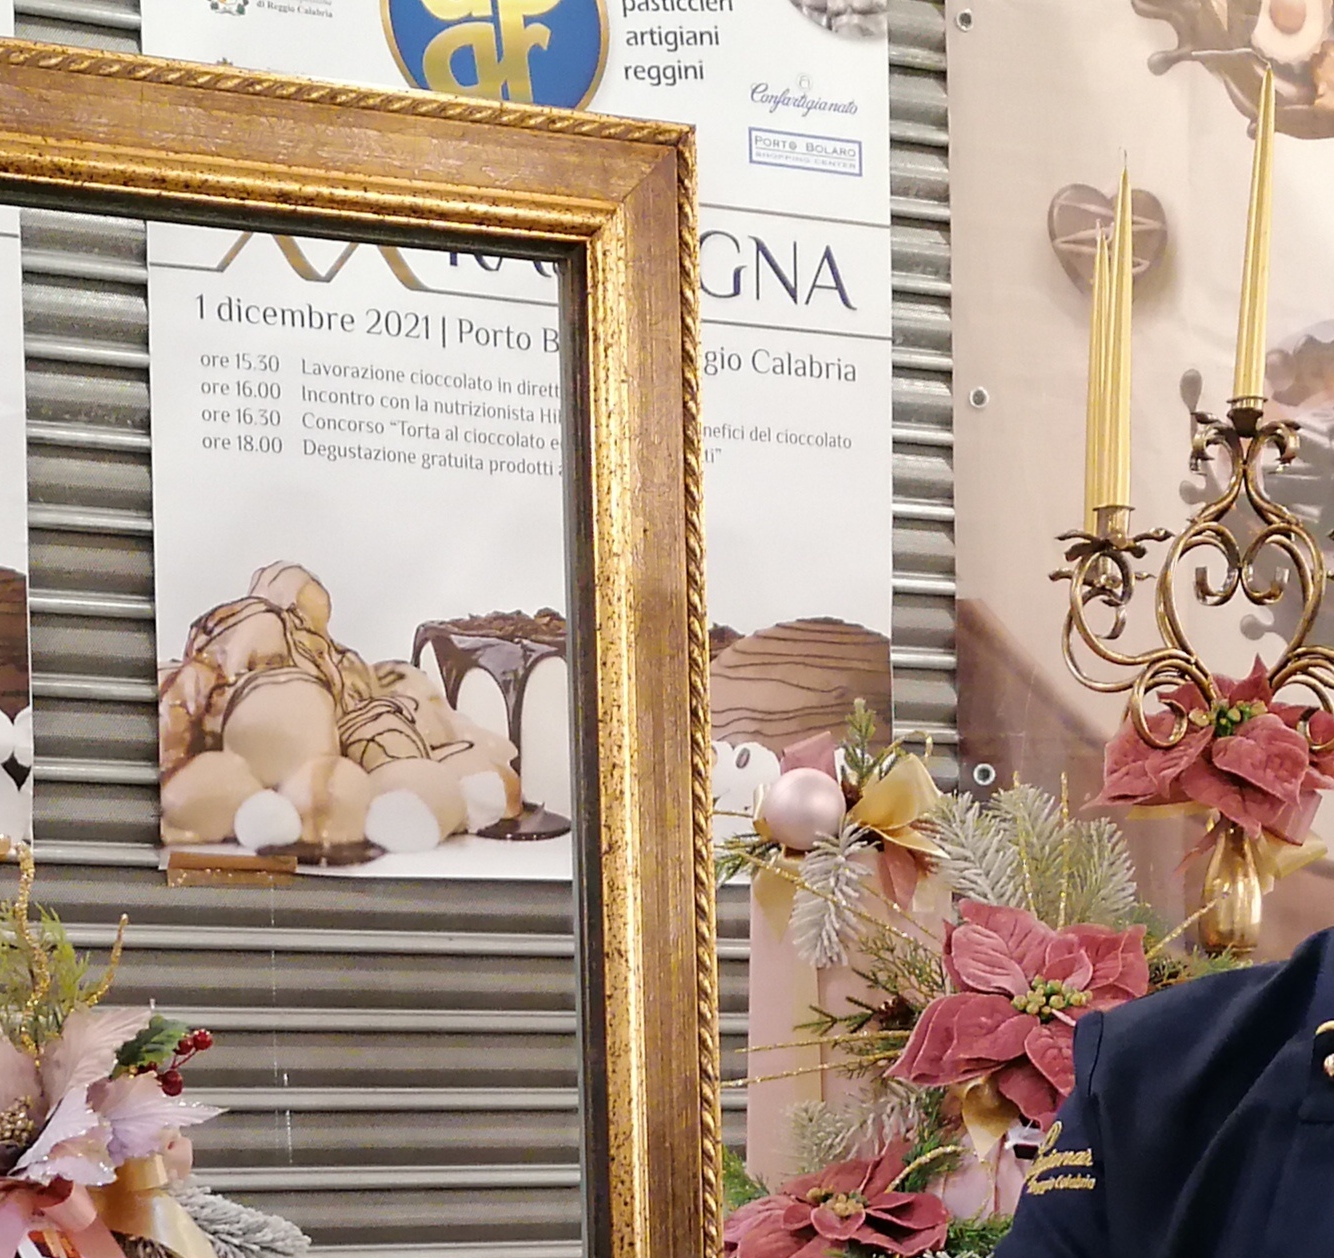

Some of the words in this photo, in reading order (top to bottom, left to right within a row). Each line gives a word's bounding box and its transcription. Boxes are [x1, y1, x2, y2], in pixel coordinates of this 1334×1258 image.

[625, 25, 720, 52] artigiani
[624, 60, 704, 86] reggini
[750, 82, 858, 118] Confartigianato
[754, 134, 798, 151] PORTO
[805, 142, 857, 158] BOLARO
[195, 293, 204, 320] 1
[217, 296, 355, 333] dicembre
[366, 308, 430, 340] 2021
[457, 318, 532, 351] Porto
[751, 348, 857, 382] Calabria
[200, 354, 230, 369] ore
[235, 352, 280, 373] 15.30
[301, 358, 405, 382] Lavorazione
[410, 369, 493, 392] cioccolato
[498, 376, 512, 394] in
[200, 381, 230, 396] ore
[236, 380, 282, 400] 16.00
[301, 385, 375, 407] Incontro
[380, 394, 410, 410] con
[415, 394, 429, 412] la
[434, 399, 535, 422] nutrizionista
[201, 408, 230, 423] ore
[236, 407, 281, 427] 16.30
[302, 412, 385, 434] Concorso
[445, 425, 459, 442] al
[464, 428, 545, 450] cioccolato
[749, 425, 772, 442] del
[776, 429, 853, 449] cioccolato
[202, 436, 231, 450] ore
[237, 434, 283, 454] 18.00
[303, 439, 417, 465] Degustazione
[421, 451, 484, 471] gratuita
[489, 457, 554, 477] prodotti
